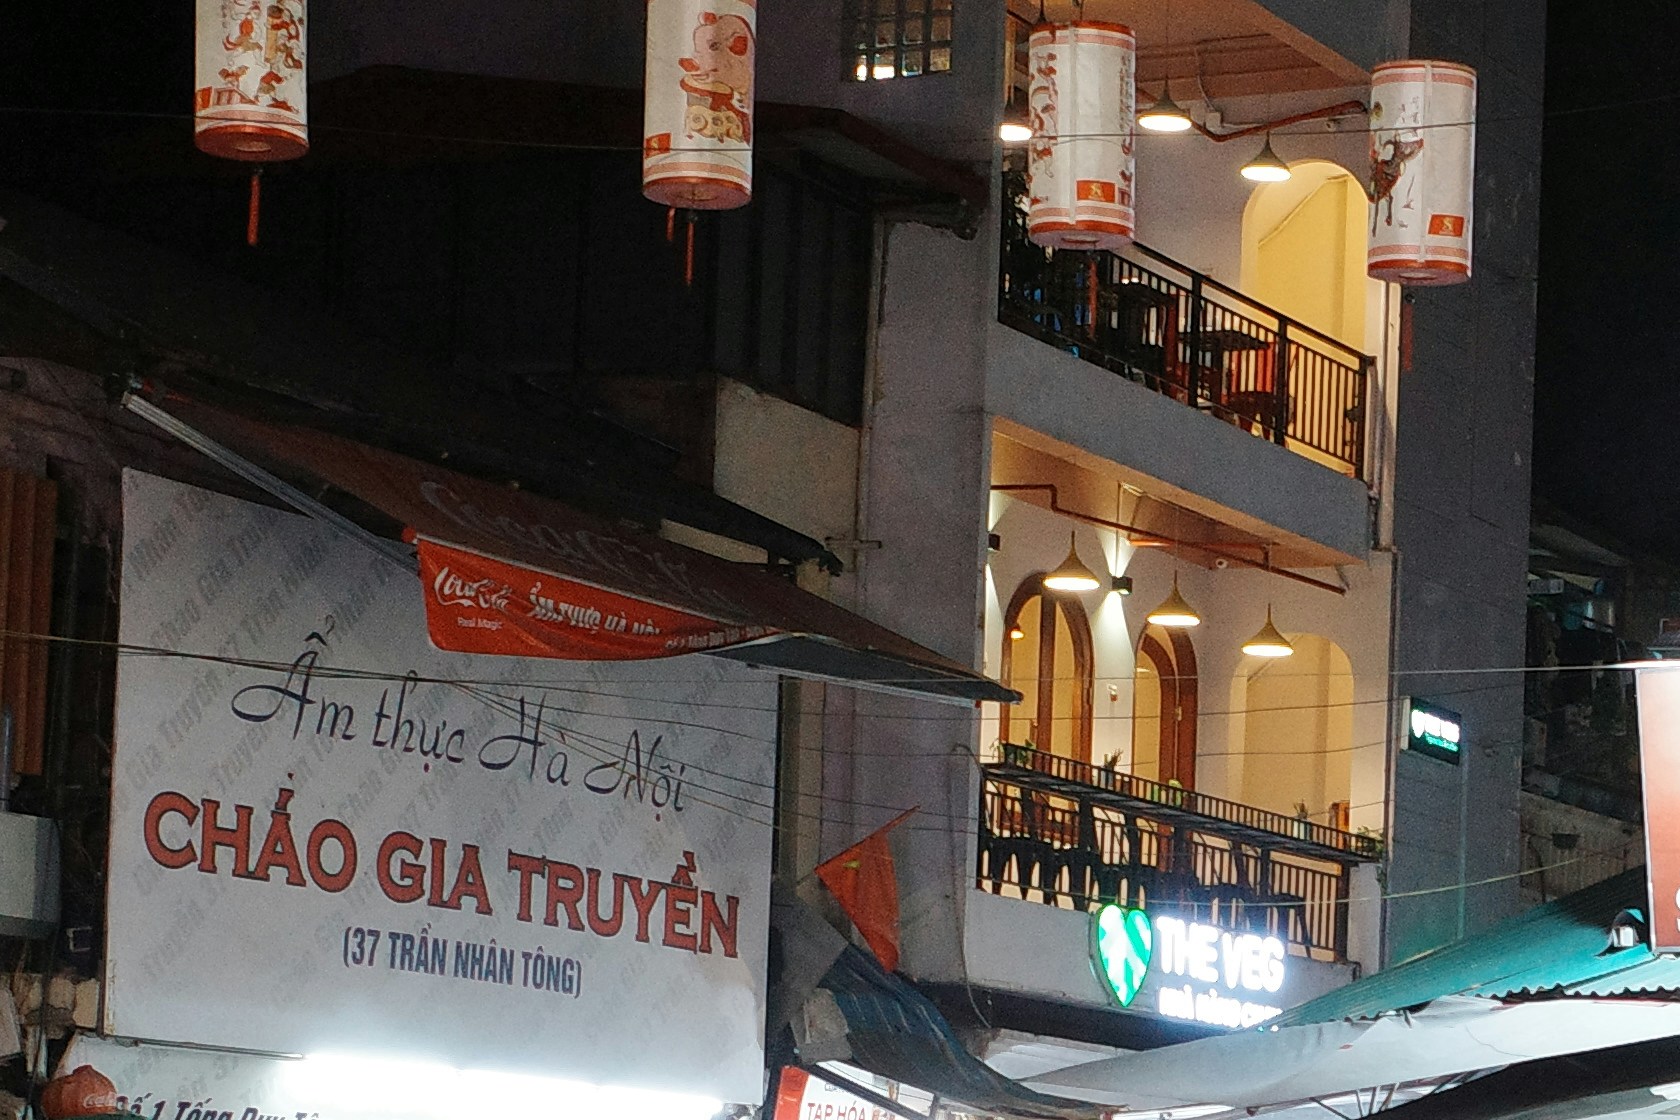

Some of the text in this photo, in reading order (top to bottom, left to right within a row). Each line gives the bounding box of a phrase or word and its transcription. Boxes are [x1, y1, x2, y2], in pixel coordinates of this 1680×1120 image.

[231, 613, 689, 822] Ẩm thực Hà Nội
[376, 829, 492, 917] GIA
[507, 849, 741, 960] TRUYỀN
[343, 926, 380, 968] (37
[453, 938, 514, 990] NHÂN
[520, 944, 584, 999] TÔNG)
